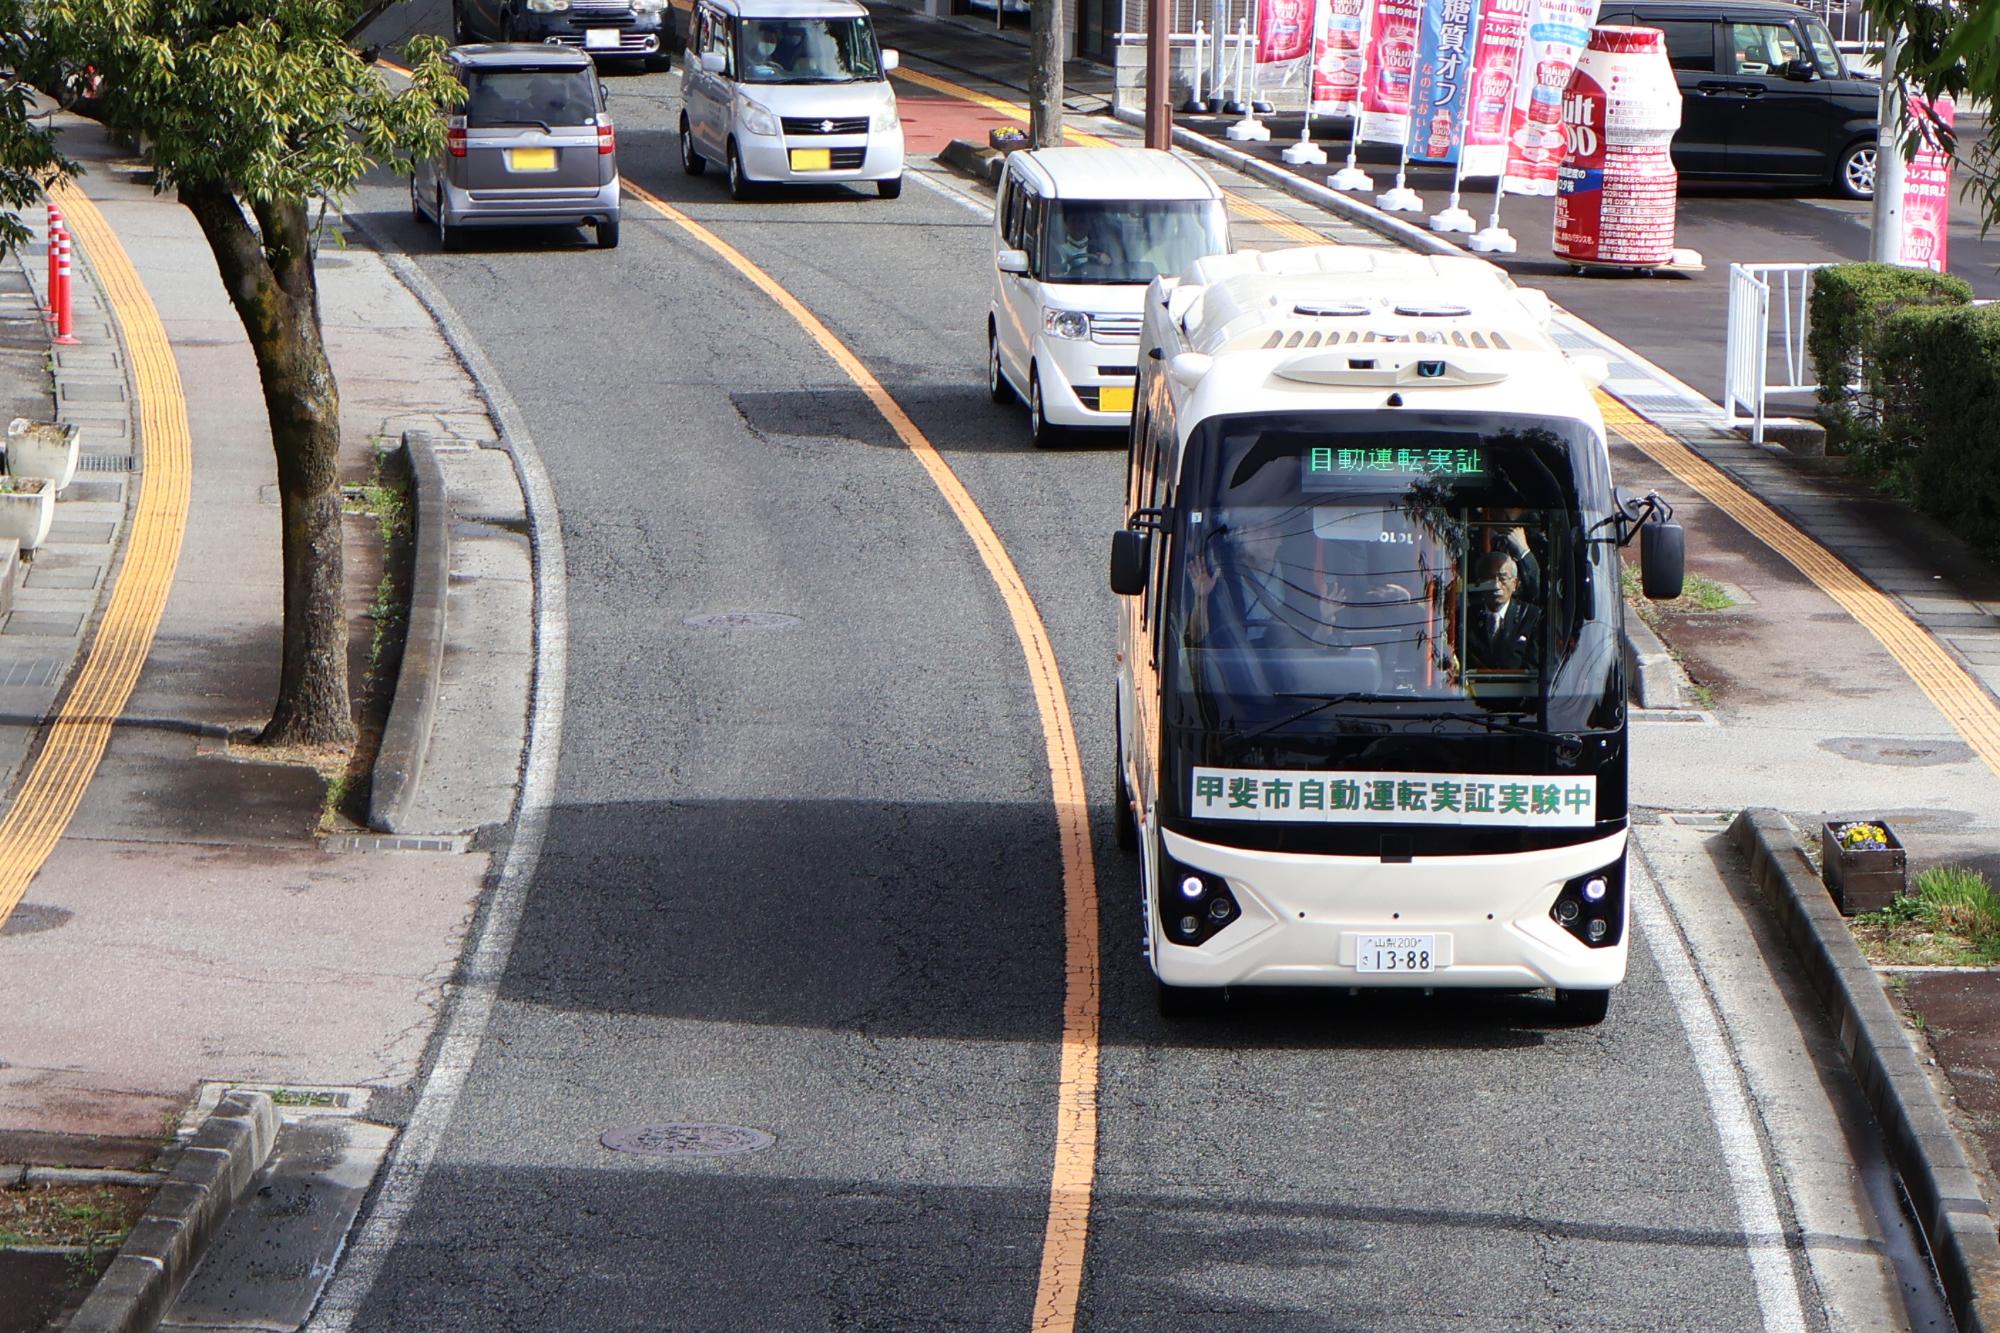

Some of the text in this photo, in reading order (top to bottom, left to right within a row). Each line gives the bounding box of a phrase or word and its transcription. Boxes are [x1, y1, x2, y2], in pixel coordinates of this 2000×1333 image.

[1434, 0, 1472, 106] 糖質オフ
[1540, 64, 1571, 77] Yakult
[1540, 75, 1569, 87] 1000
[1196, 775, 1591, 815] 甲斐市自動運転実証実験中
